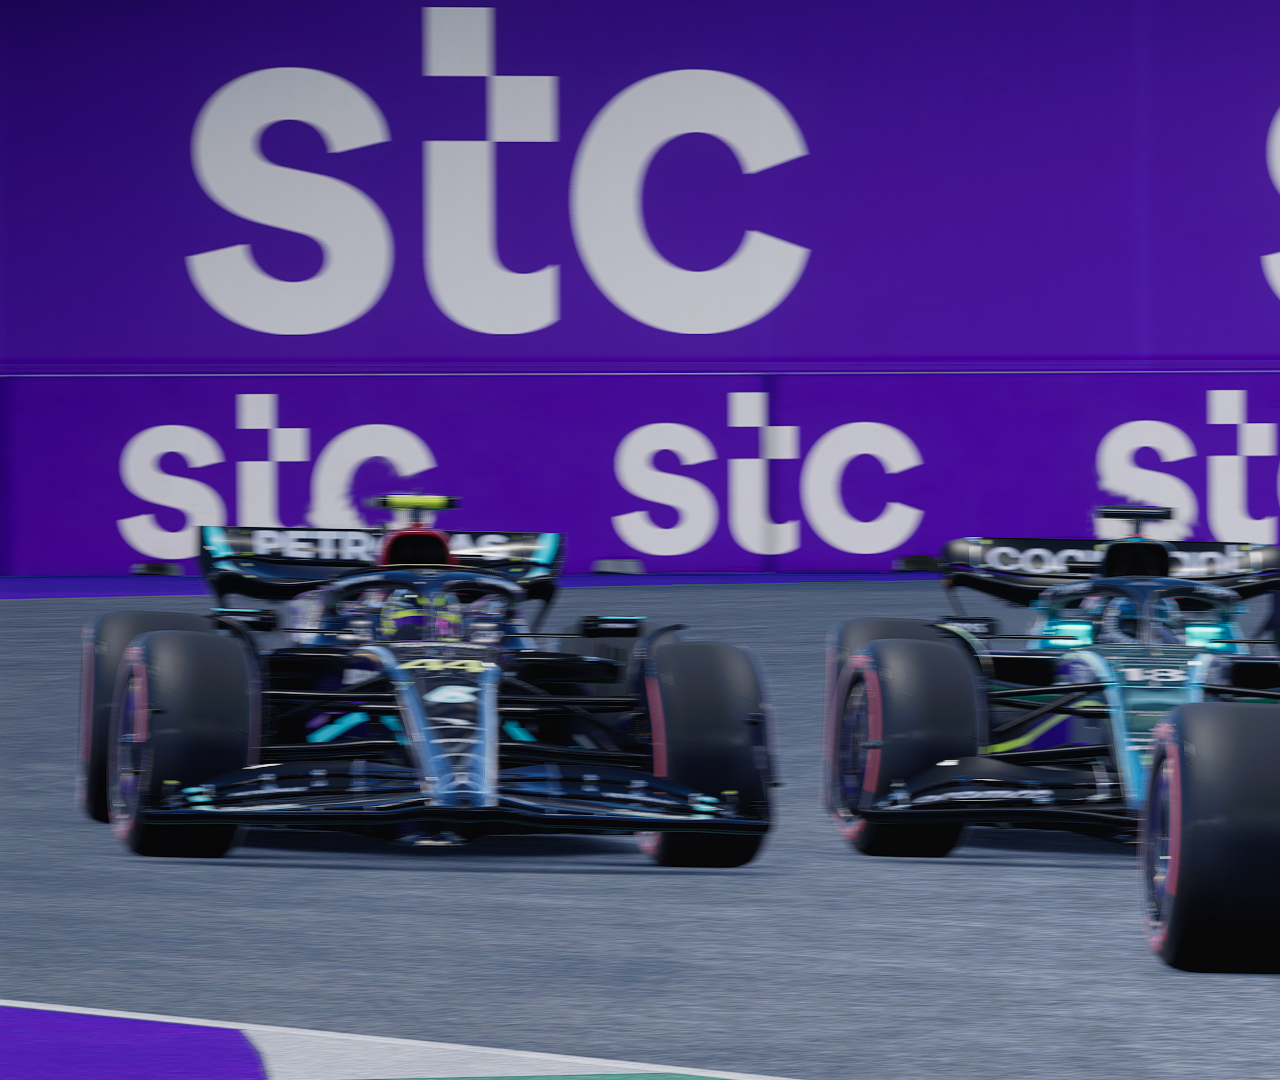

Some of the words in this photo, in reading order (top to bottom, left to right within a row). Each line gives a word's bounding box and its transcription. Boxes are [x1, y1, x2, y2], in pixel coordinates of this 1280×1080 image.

[185, 6, 811, 336] stc
[116, 393, 438, 560] stc
[251, 529, 511, 561] PETRAS
[610, 392, 925, 556] stc
[984, 545, 1247, 575] cogant
